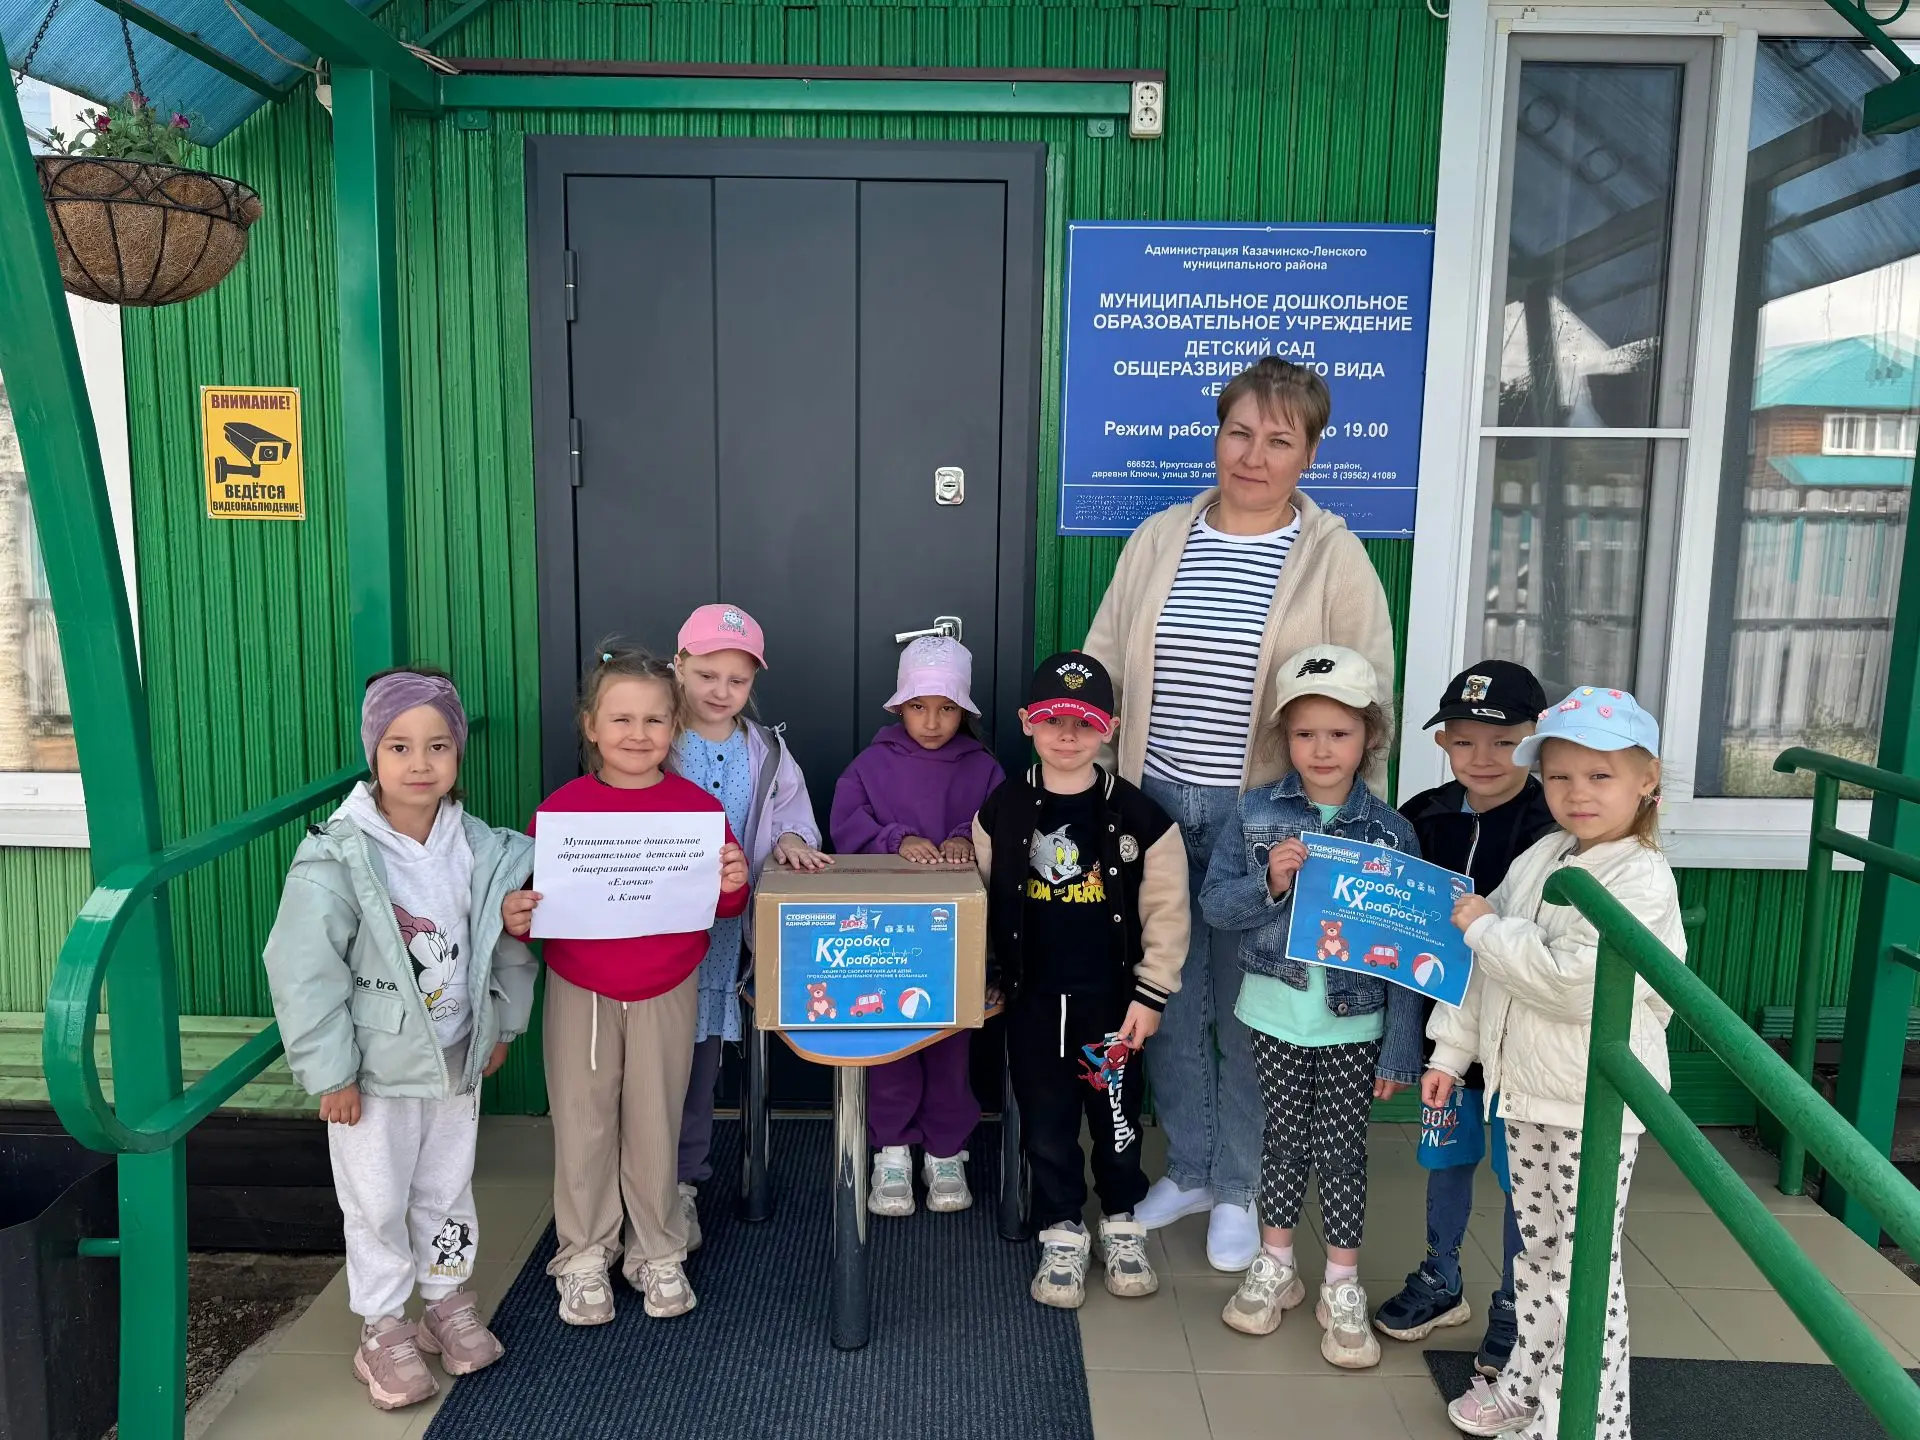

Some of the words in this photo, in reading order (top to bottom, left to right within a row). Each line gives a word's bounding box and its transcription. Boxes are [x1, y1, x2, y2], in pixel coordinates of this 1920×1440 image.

[1144, 244, 1239, 257] Администрация
[1242, 245, 1367, 257] Казачинско-Ленского
[1183, 260, 1282, 272] муниципального
[1285, 258, 1328, 271] района
[1099, 293, 1269, 311] МУНИЦИПАЛЬНОЕ
[1273, 295, 1408, 312] ДОШКОЛЬНОЕ
[1093, 315, 1280, 331] ОБРАЗОВАТЕЛЬНОЕ
[1286, 316, 1413, 332] УЧРЕЖДЕНИЕ
[1184, 338, 1271, 357] ДЕТСКИЙ
[1276, 341, 1315, 358] САД
[1334, 362, 1386, 380] ВИДА
[211, 394, 291, 410] ВНИМАНИЕ!
[1104, 421, 1163, 436] Режим
[1169, 421, 1220, 439] работ
[1343, 422, 1388, 438] 19.00
[1160, 461, 1203, 470] Иркутская
[1334, 461, 1362, 471] район,
[1130, 470, 1160, 479] Ключи,
[1162, 471, 1188, 480] улица
[1190, 470, 1200, 478] 30
[1300, 471, 1330, 481] лефон:
[1332, 471, 1338, 479] 8
[1340, 471, 1370, 481] (39562)
[1372, 471, 1397, 480] 41089
[225, 482, 286, 501] ВЕДЁТСЯ
[212, 501, 300, 513] ВИДЕОНАБЛЮДЕНИЕ
[1056, 662, 1093, 680] RUSSIA
[562, 837, 641, 848] Муниципальное
[644, 836, 701, 846] дошкольное
[557, 851, 642, 862] образовательное
[646, 850, 687, 859] детский
[688, 850, 705, 859] сад
[1307, 843, 1360, 859] СТОРОННИКИ
[1309, 851, 1333, 861] ДИНОЙ
[1333, 855, 1360, 865] РОССИИ
[572, 864, 665, 876] общеразвивающего
[667, 864, 689, 873] вида
[608, 877, 654, 887] «Елочка»
[1333, 874, 1412, 903] Коробка
[618, 893, 652, 902] Ключи
[1026, 879, 1052, 901] TOM
[1061, 884, 1107, 903] JERR
[1348, 889, 1427, 927] Храбрости
[785, 913, 837, 921] СТОРОННИКИ
[815, 934, 891, 962] Коробка
[830, 948, 908, 968] Храбрости
[356, 976, 371, 988] Be
[376, 978, 399, 991] bra
